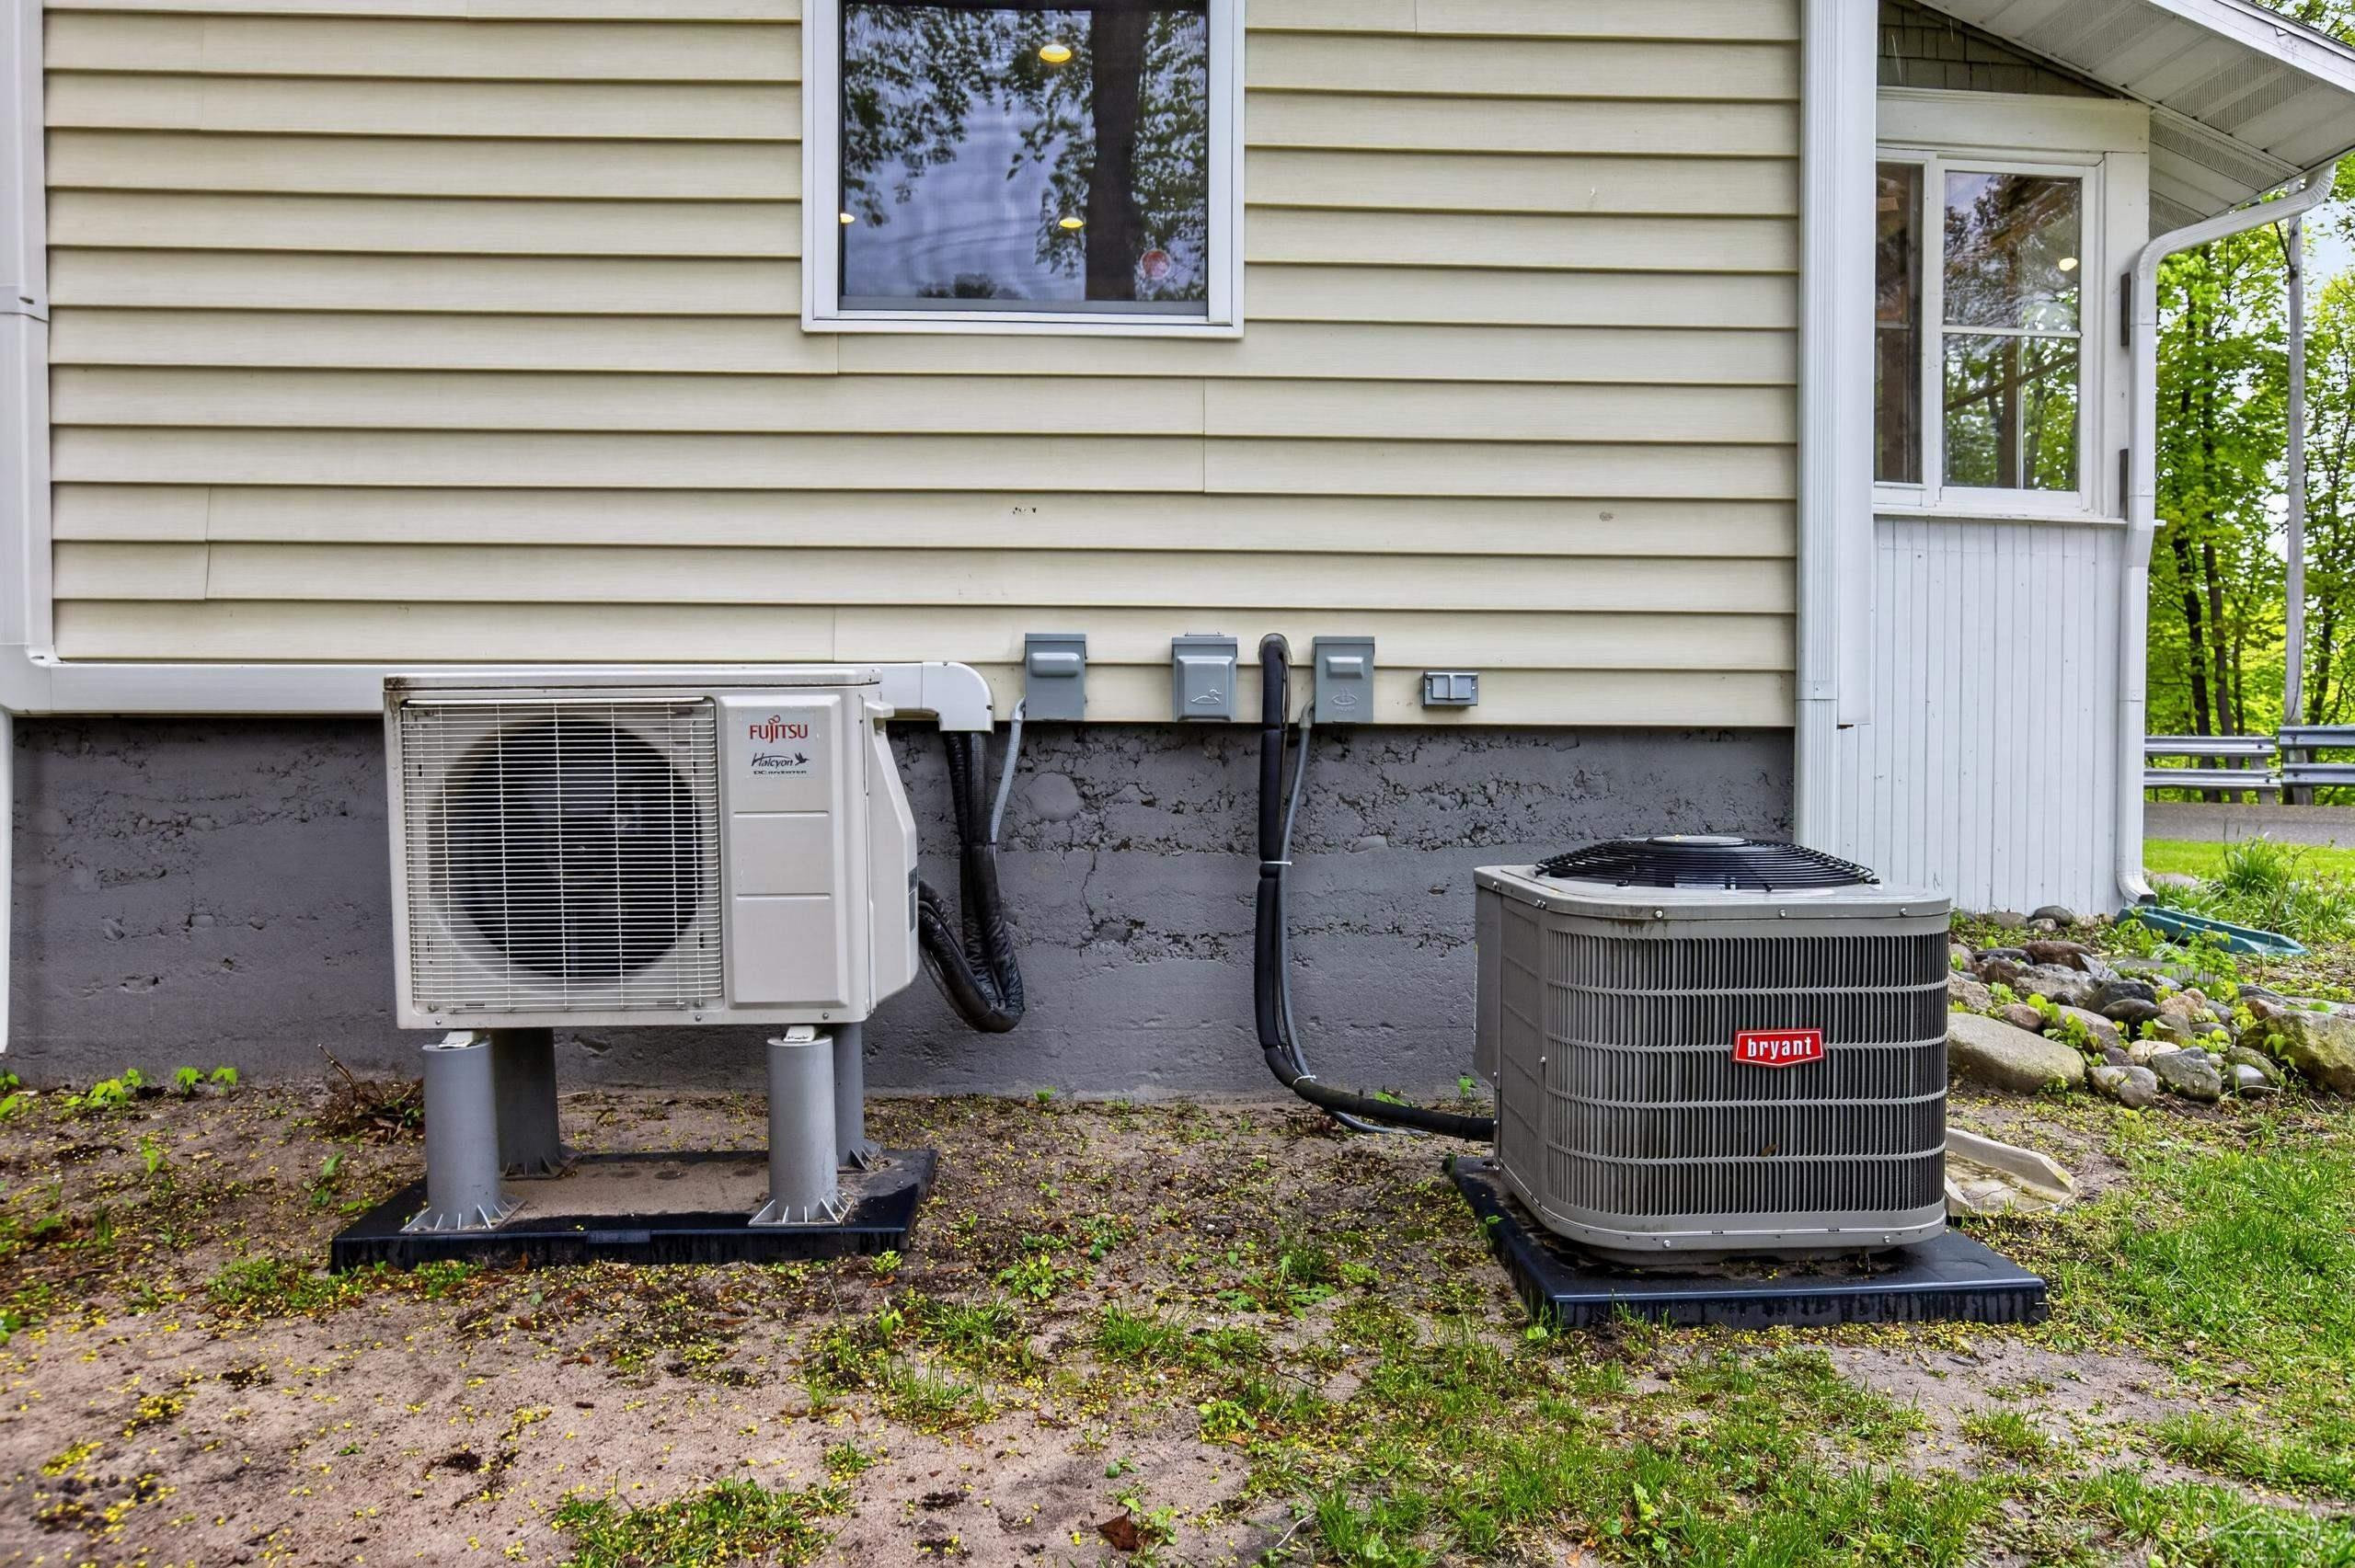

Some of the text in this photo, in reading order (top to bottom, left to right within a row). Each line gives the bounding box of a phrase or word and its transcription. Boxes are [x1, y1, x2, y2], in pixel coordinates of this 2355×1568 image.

[749, 715, 809, 743] FUJITSU
[751, 752, 793, 769] Halcyon
[1747, 1036, 1811, 1059] bryant
